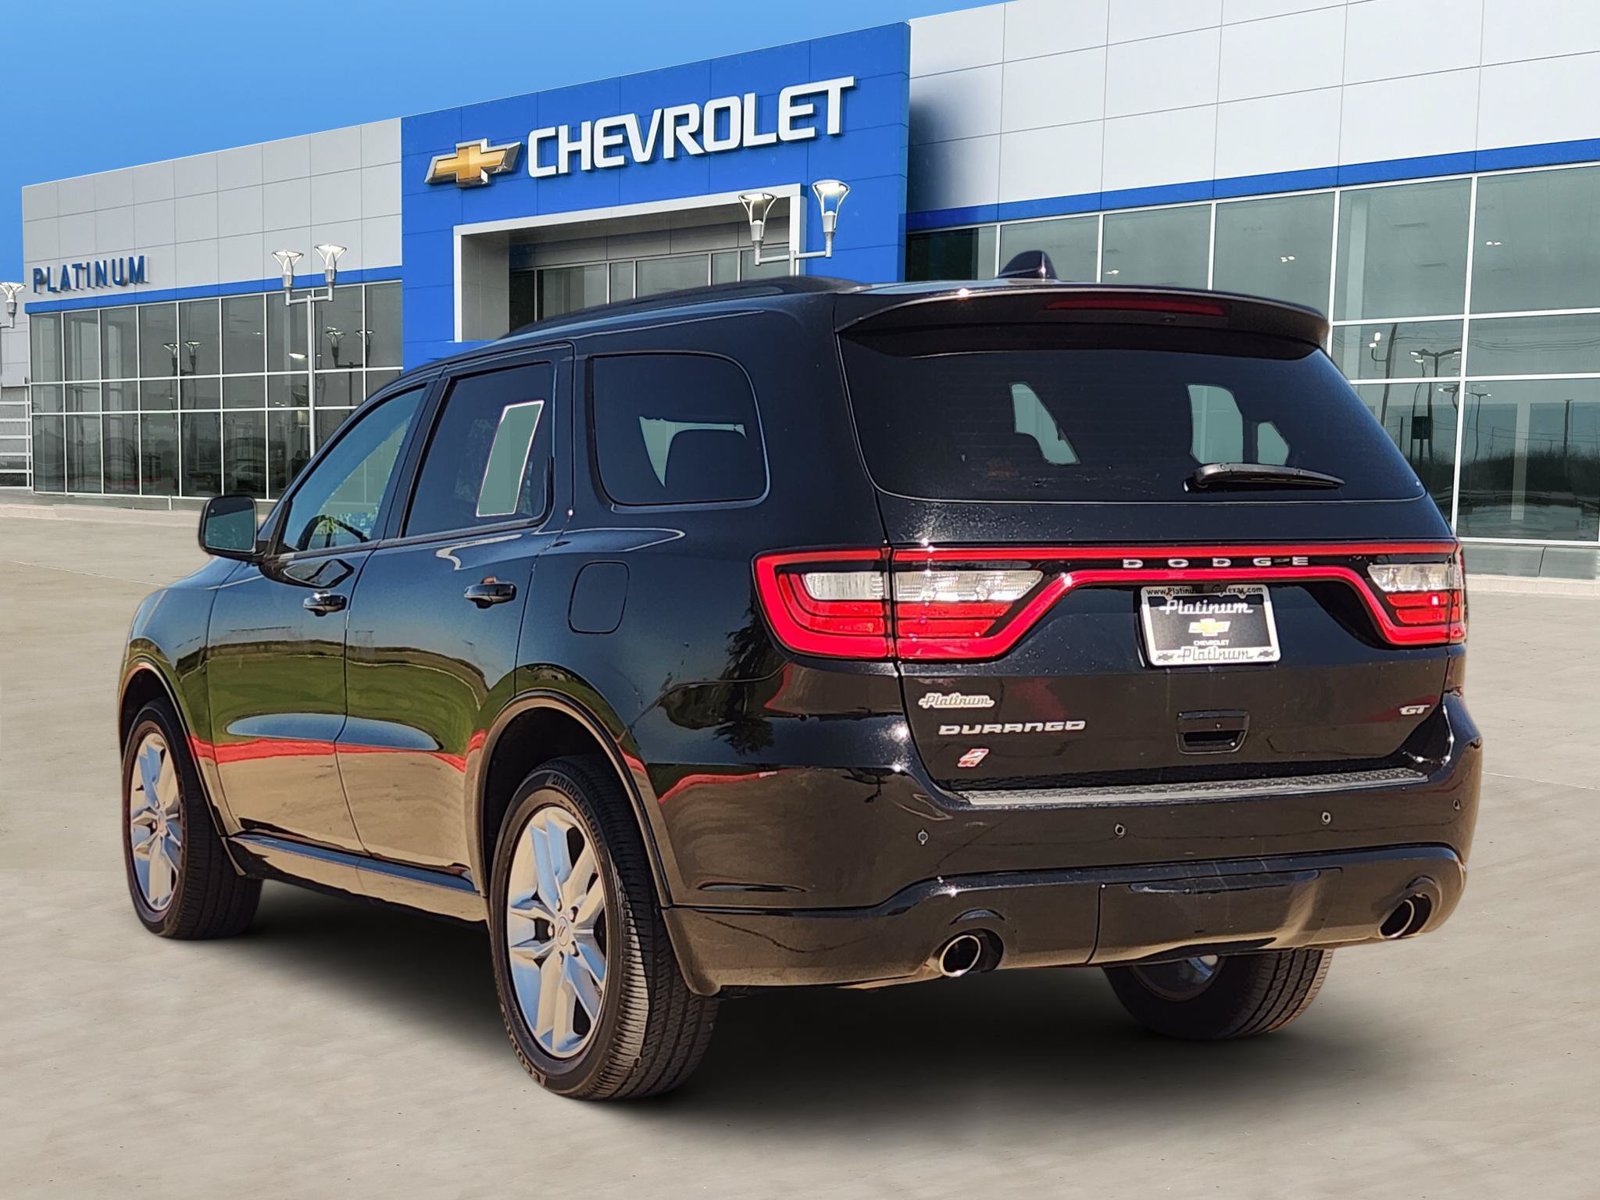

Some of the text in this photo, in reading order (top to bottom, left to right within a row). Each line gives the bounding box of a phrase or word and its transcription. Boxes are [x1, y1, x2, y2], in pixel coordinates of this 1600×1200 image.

[527, 75, 855, 178] CHEVROLET
[33, 255, 147, 293] PLATINUM
[1122, 557, 1309, 569] DODGE
[1159, 600, 1254, 615] Platinum
[1177, 646, 1254, 662] Platinum
[918, 692, 995, 709] Platinum
[1399, 704, 1431, 715] GT
[938, 720, 1086, 735] DURANGO
